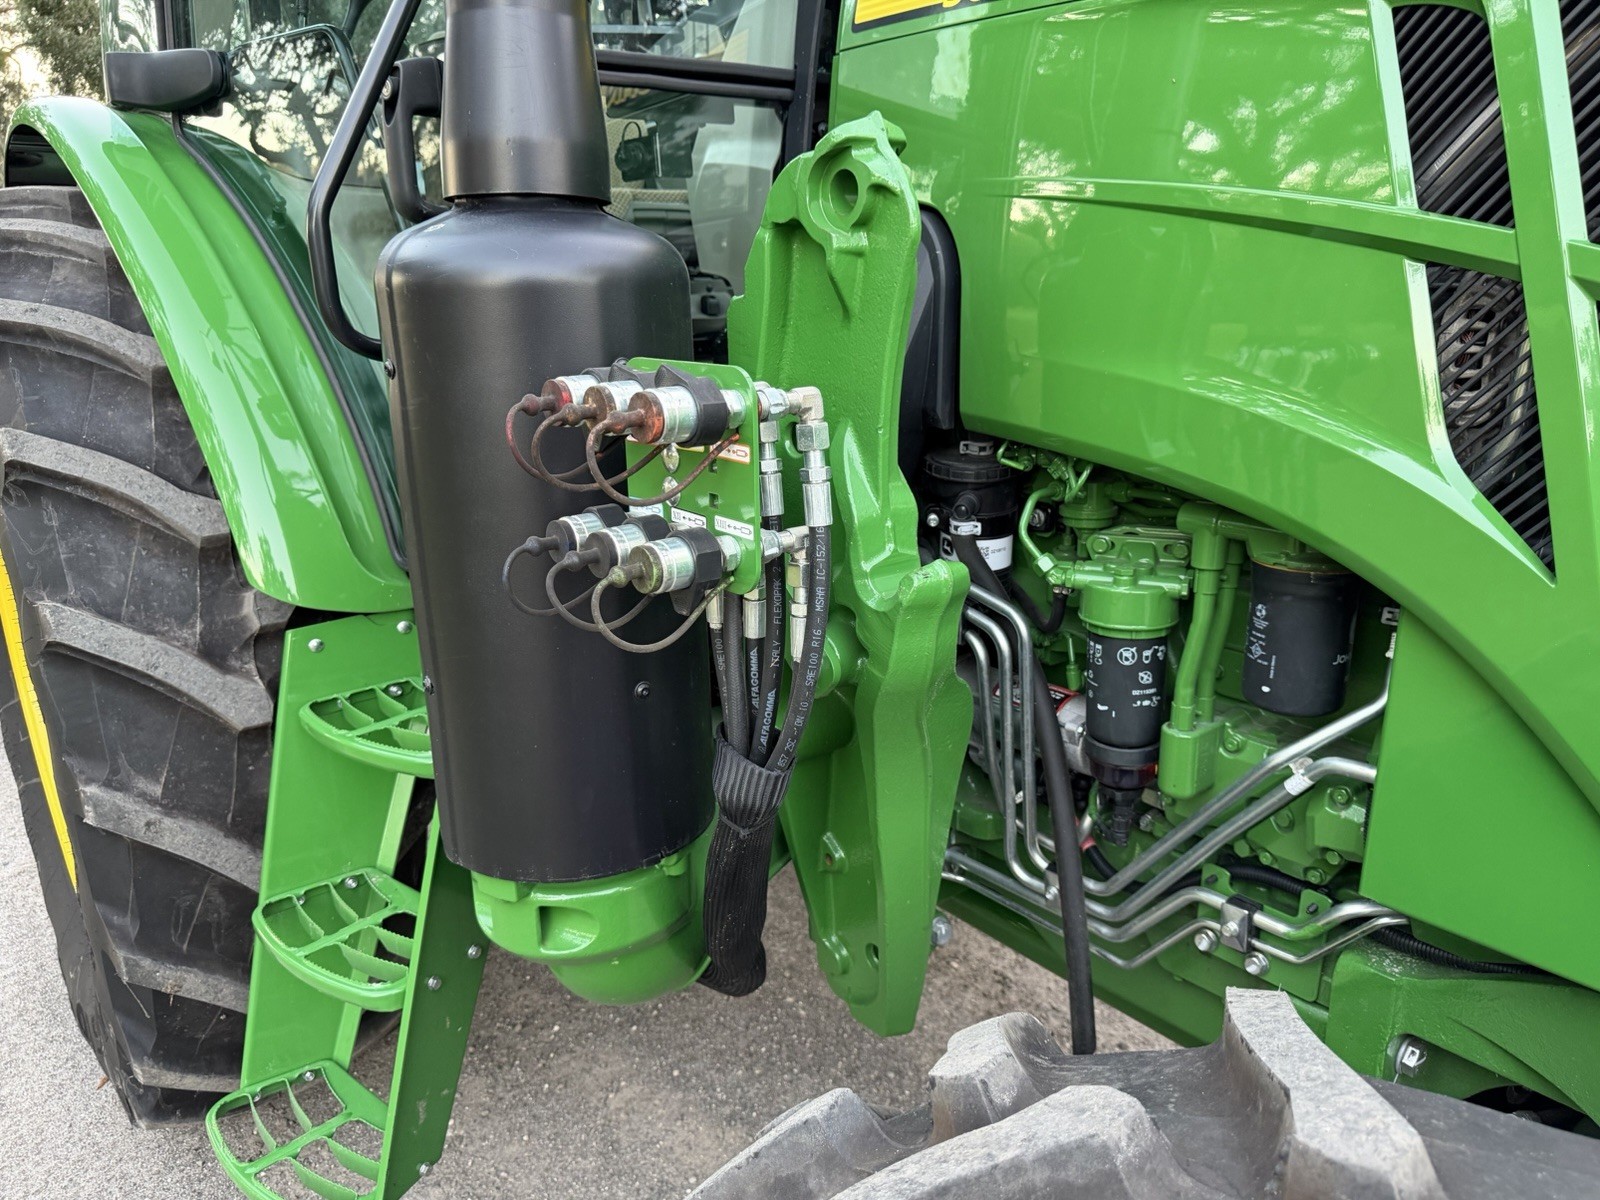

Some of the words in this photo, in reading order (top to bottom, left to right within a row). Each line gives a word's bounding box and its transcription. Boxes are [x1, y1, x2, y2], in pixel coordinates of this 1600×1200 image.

[773, 579, 782, 625] FLEXOPAK
[815, 586, 826, 612] MSHA
[715, 638, 726, 671] SAE100
[770, 640, 781, 668] ITALY
[811, 629, 822, 649] R16
[750, 647, 759, 708] ALFAGOMMA
[805, 652, 818, 687] SAE100
[761, 688, 777, 746] ALFAGOMMA
[800, 701, 809, 711] 10
